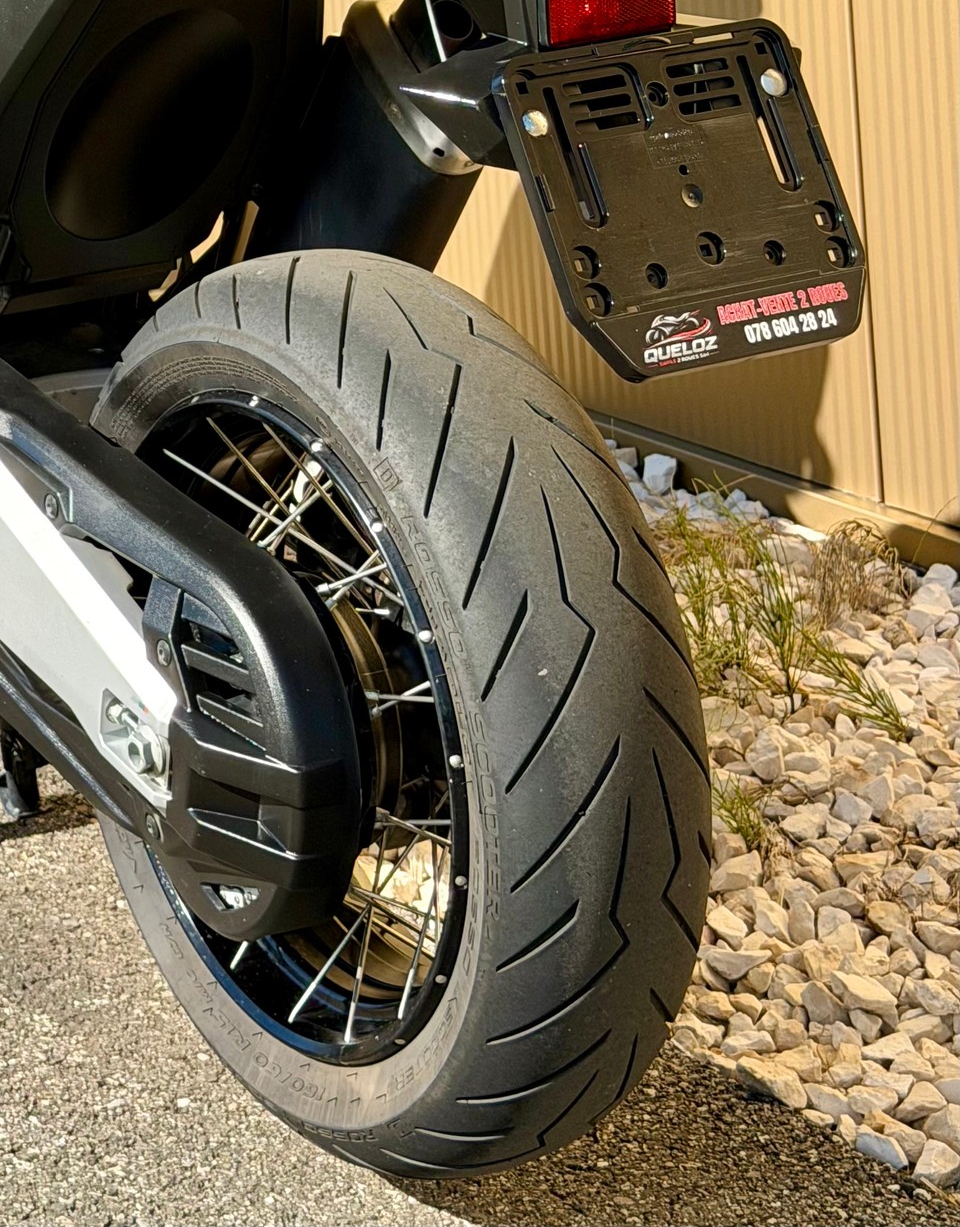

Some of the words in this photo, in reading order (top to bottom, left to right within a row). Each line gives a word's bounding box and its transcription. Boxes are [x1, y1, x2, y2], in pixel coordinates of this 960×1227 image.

[716, 291, 798, 326] ACHAT-VENTE
[796, 289, 810, 309] 2
[807, 281, 849, 306] ROUES
[743, 321, 772, 344] 078
[771, 315, 800, 338] 604
[798, 311, 818, 333] 28
[817, 307, 838, 329] 24
[643, 335, 719, 364] QUELOZ
